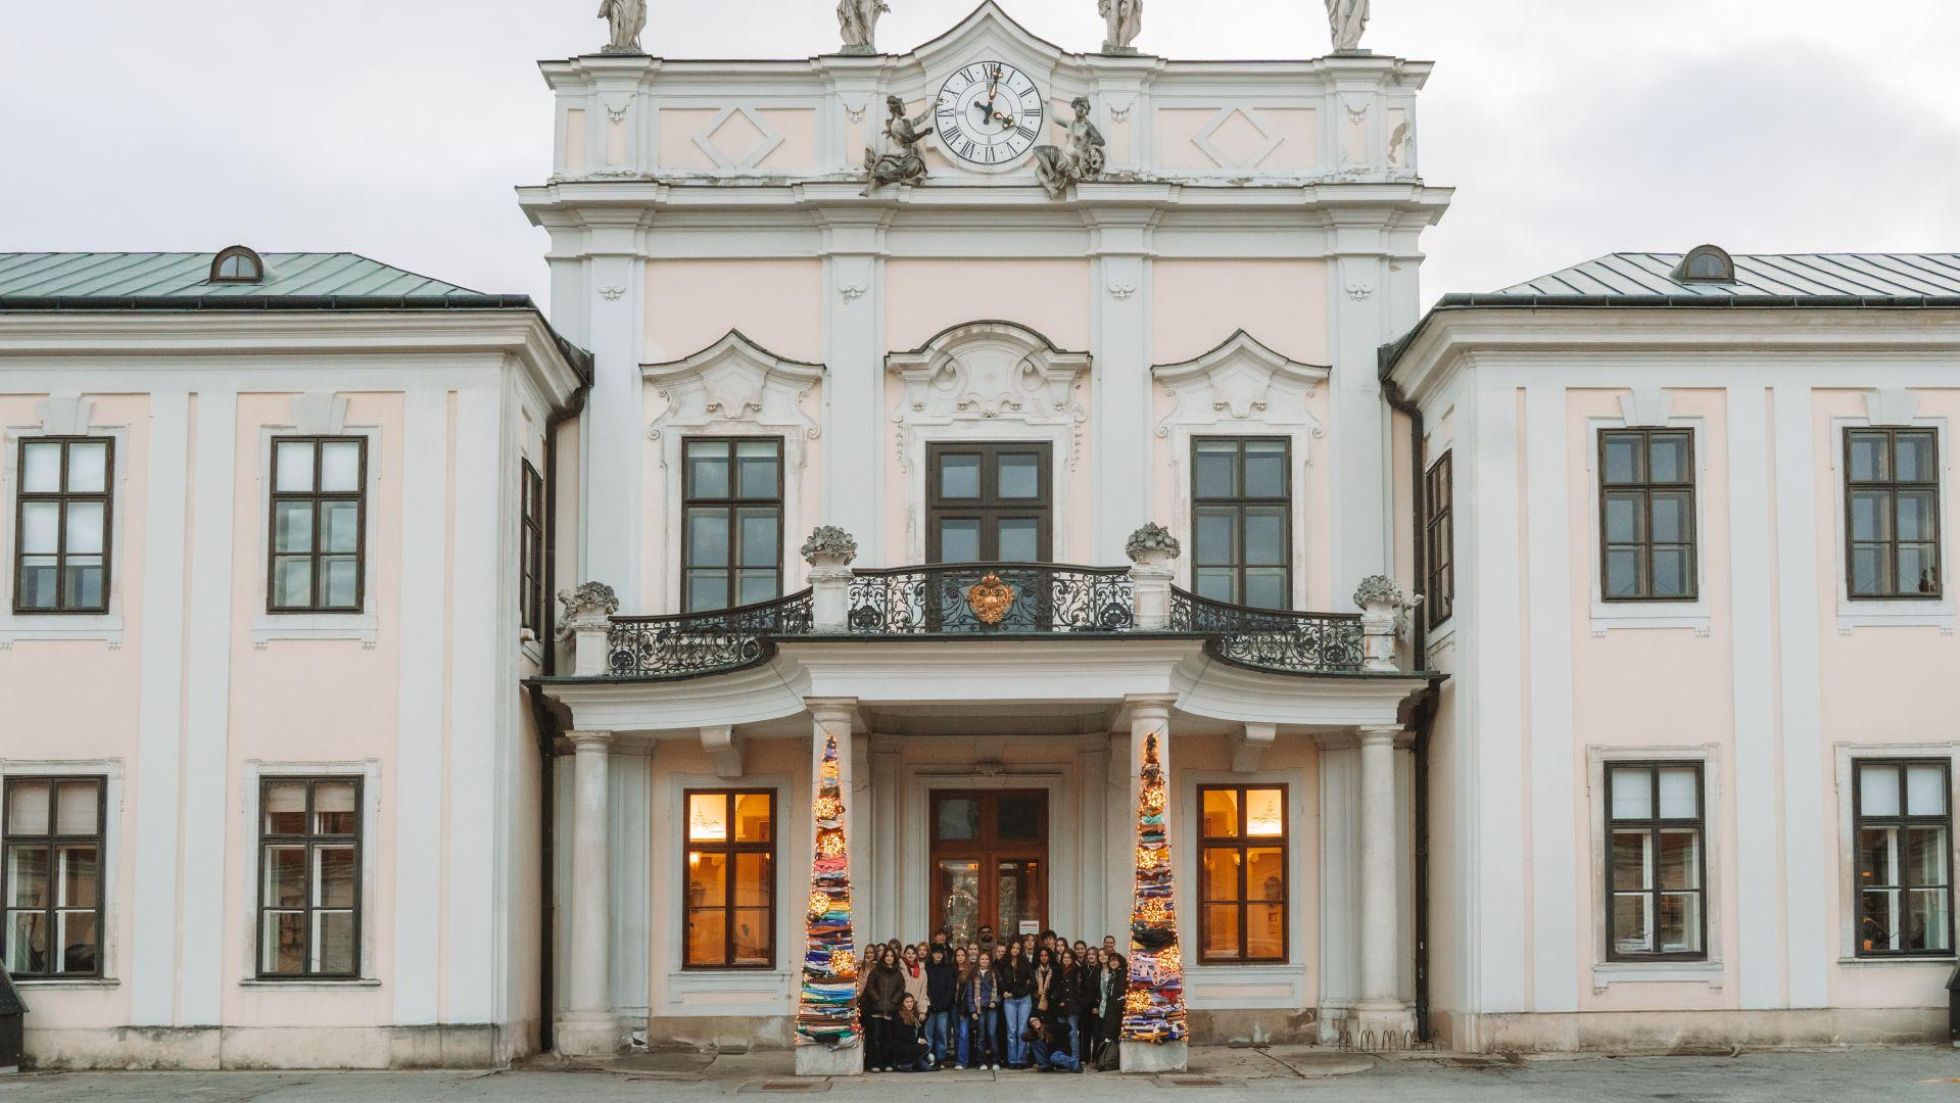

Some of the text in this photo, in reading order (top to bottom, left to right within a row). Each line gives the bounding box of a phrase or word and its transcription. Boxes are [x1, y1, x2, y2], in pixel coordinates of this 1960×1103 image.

[960, 68, 975, 86] XI
[1006, 70, 1016, 84] I
[943, 85, 960, 99] X
[1018, 86, 1035, 98] II
[937, 108, 955, 118] IX
[1024, 108, 1041, 117] III
[943, 125, 962, 146] VIII
[1017, 125, 1037, 142] IIII
[960, 140, 976, 159] VII
[985, 146, 996, 162] VI
[1005, 141, 1018, 158] V
